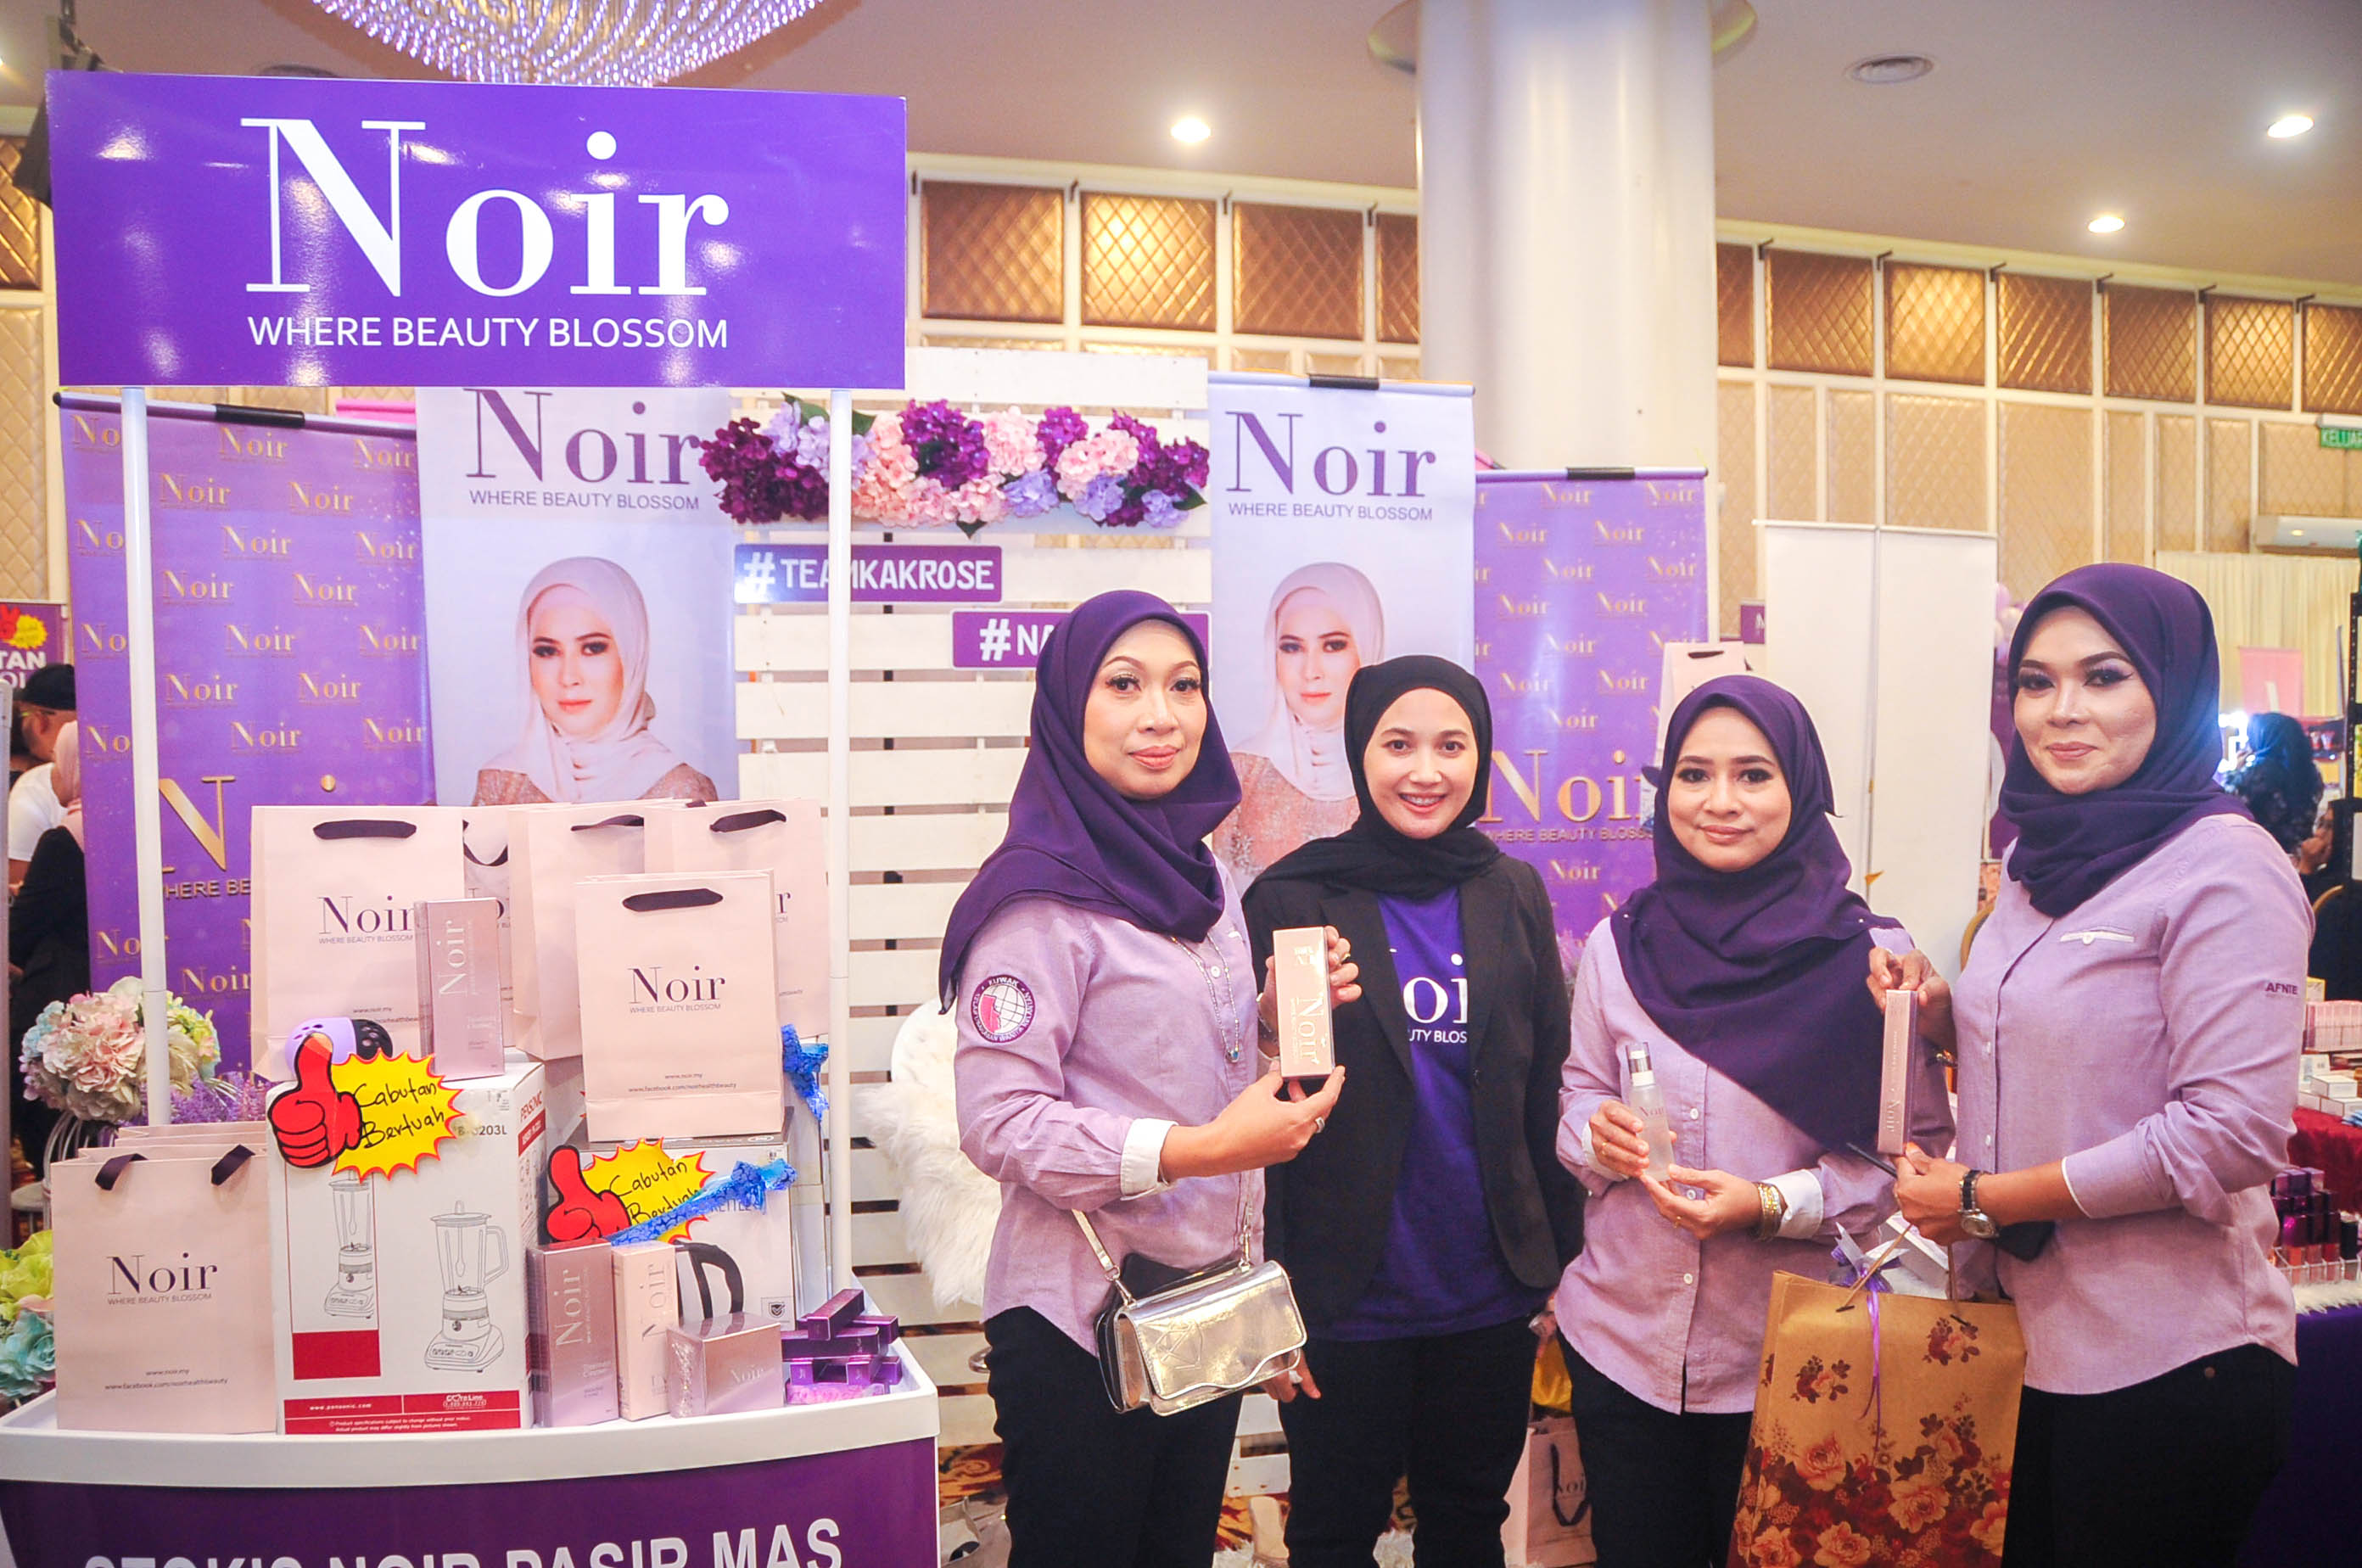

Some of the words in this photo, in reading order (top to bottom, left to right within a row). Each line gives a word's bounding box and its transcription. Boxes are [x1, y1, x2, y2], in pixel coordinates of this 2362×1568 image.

[241, 117, 729, 296] Noir
[248, 316, 381, 346] WHERE
[392, 316, 538, 346] BEAUTY
[549, 318, 728, 348] BLOSSOM
[71, 415, 120, 446] No
[220, 427, 288, 458] Noir
[463, 388, 701, 484] Noir
[353, 439, 414, 467] Noir
[1225, 412, 1436, 497] Noir
[160, 473, 230, 504] Noir
[289, 482, 353, 511] Noir
[469, 490, 536, 505] WHERE
[543, 491, 612, 507] BEAUTY
[618, 494, 700, 510] BLOSSOM
[1542, 483, 1592, 504] Noir
[1645, 482, 1695, 503] Noir
[1229, 502, 1287, 517] WHERE
[1293, 504, 1354, 518] BEAUTY
[1358, 506, 1432, 521] BLOSSOM
[75, 519, 123, 549] No
[221, 525, 291, 555] Noir
[1498, 522, 1548, 543] Noir
[1595, 520, 1644, 542] Noir
[356, 532, 416, 560] Noir
[743, 552, 994, 591] #TEAKAKROSE
[1544, 557, 1593, 579] Noir
[1648, 557, 1696, 578] Noir
[163, 570, 234, 599] Noir
[293, 574, 357, 601] Noir
[1499, 595, 1549, 615] Noir
[1597, 592, 1647, 613] Noir
[81, 624, 126, 652] No
[225, 624, 295, 652] Noir
[360, 624, 419, 651] Noir
[165, 674, 238, 703] Noir
[299, 673, 361, 701] Noir
[1501, 672, 1550, 692] Noir
[1598, 669, 1648, 691] Noir
[87, 726, 130, 753] No
[231, 721, 302, 748] Noir
[363, 718, 424, 744] Noir
[1479, 750, 1642, 823] Noi
[1540, 827, 1596, 843] BEAUTY
[1551, 860, 1602, 881] Noir
[164, 880, 220, 899] HERE
[317, 895, 414, 934] Noir
[95, 929, 141, 959] No
[437, 920, 467, 998] Noir
[627, 966, 725, 1004] Noir
[1403, 954, 1468, 1023] oi
[686, 1003, 721, 1011] BLOSSOM
[1296, 996, 1326, 1065] Noir
[1408, 1029, 1431, 1042] UTY
[1434, 1030, 1468, 1043] BLOS
[354, 1078, 437, 1108] Cabutan
[361, 1106, 445, 1149] Bertuah
[609, 1161, 687, 1197] Cabutan
[107, 1252, 217, 1294] Noir
[138, 1296, 171, 1304] BEAUTY
[171, 1293, 212, 1302] BLOSSOM
[553, 1269, 584, 1347] Noir
[640, 1264, 667, 1341] Noir
[730, 1364, 765, 1384] Noir
